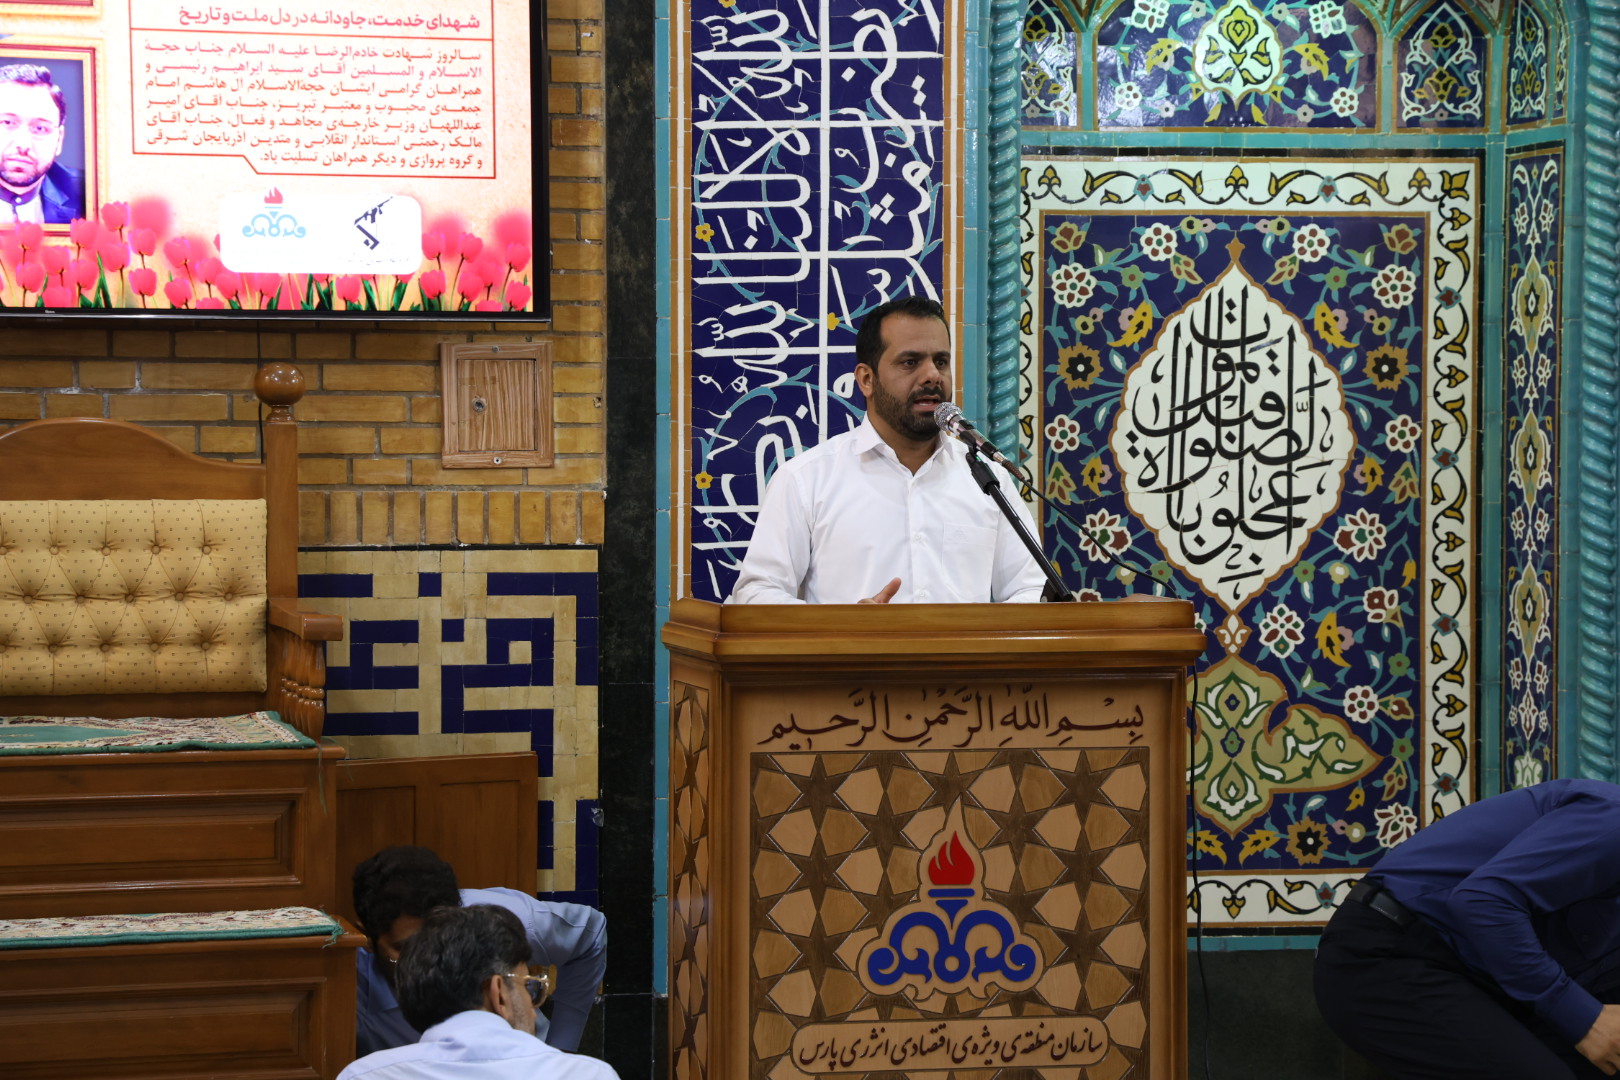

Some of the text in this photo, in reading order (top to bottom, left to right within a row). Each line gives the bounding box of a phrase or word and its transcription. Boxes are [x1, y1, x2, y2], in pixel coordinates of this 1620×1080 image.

[179, 6, 221, 26] تاریخ
[223, 12, 231, 25] و
[231, 8, 268, 22] ملت
[270, 8, 291, 25] دل
[292, 14, 309, 27] در
[310, 10, 366, 29] جاودانه
[426, 13, 480, 33] شهدای
[185, 42, 223, 53] جناب
[229, 43, 274, 56] السلام
[278, 45, 309, 58] علیه
[383, 47, 432, 62] شهادت
[437, 49, 481, 64] سالروز
[146, 63, 151, 73] و
[213, 61, 262, 76] ابراهیم
[268, 65, 303, 75] سید
[351, 65, 414, 79] المسلمین
[429, 66, 482, 78] الاسلام
[419, 71, 424, 80] و
[146, 76, 180, 89] امام
[184, 77, 227, 91] هاشم
[330, 81, 375, 96] ایشان
[378, 83, 422, 98] گرامی
[426, 84, 482, 99] همراهان
[147, 95, 180, 108] امیر
[226, 97, 268, 110] جناب
[322, 101, 362, 113] معتبر
[366, 105, 371, 114] و
[374, 104, 426, 115] محبوب
[184, 113, 223, 126] جناب
[270, 120, 275, 130] و
[279, 116, 322, 129] مجاهد
[384, 121, 415, 133] وزیر
[419, 119, 482, 134] عبداللهیان
[147, 129, 188, 145] شرقی
[250, 135, 291, 147] متدین
[295, 138, 300, 148] و
[304, 133, 348, 149] انقلابی
[352, 135, 400, 149] استاندار
[449, 136, 483, 148] مالک
[403, 138, 445, 151] رحمتی
[281, 151, 318, 163] تسلیت
[322, 152, 368, 167] همراهان
[372, 152, 396, 167] دیگر
[400, 158, 406, 168] و
[409, 153, 445, 168] پروازی
[449, 154, 474, 169] گروه
[477, 159, 483, 170] و
[839, 1026, 889, 1067] انرژی
[890, 1024, 950, 1065] اقتصادی
[1050, 1027, 1103, 1061] سازمان
[800, 1037, 838, 1071] پارس
